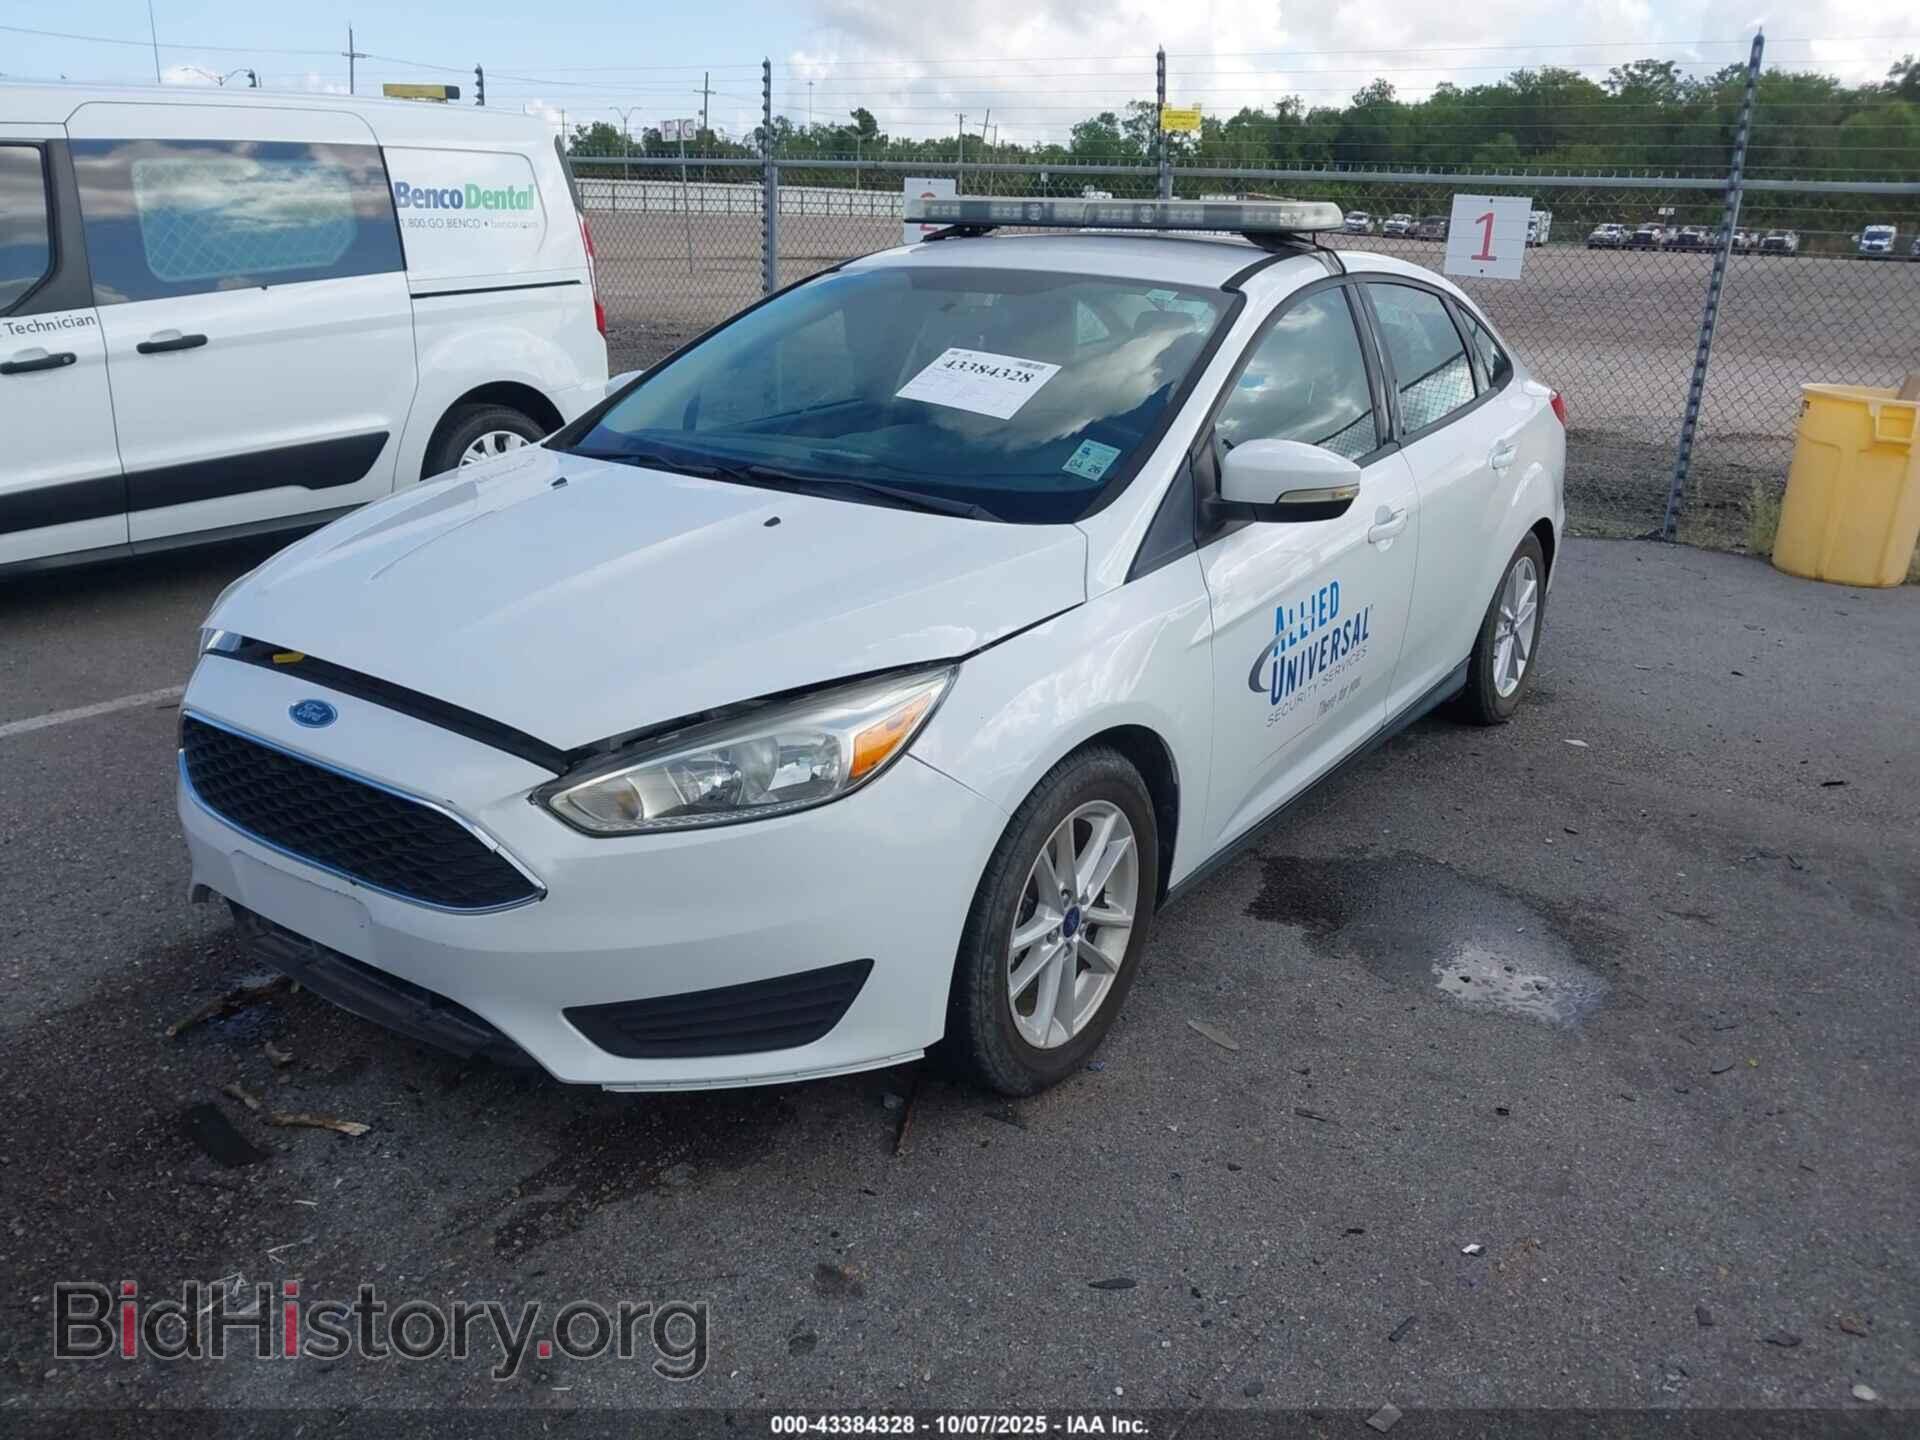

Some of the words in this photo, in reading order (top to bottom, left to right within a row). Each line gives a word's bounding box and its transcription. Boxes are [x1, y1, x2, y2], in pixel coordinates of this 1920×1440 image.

[394, 181, 534, 209] BencoDental
[1471, 212, 1497, 261] 1
[3, 315, 96, 335] Technician
[944, 359, 1035, 384] 43384328
[1273, 580, 1340, 658] ALLIED
[1270, 606, 1369, 706] UNIVERSAL
